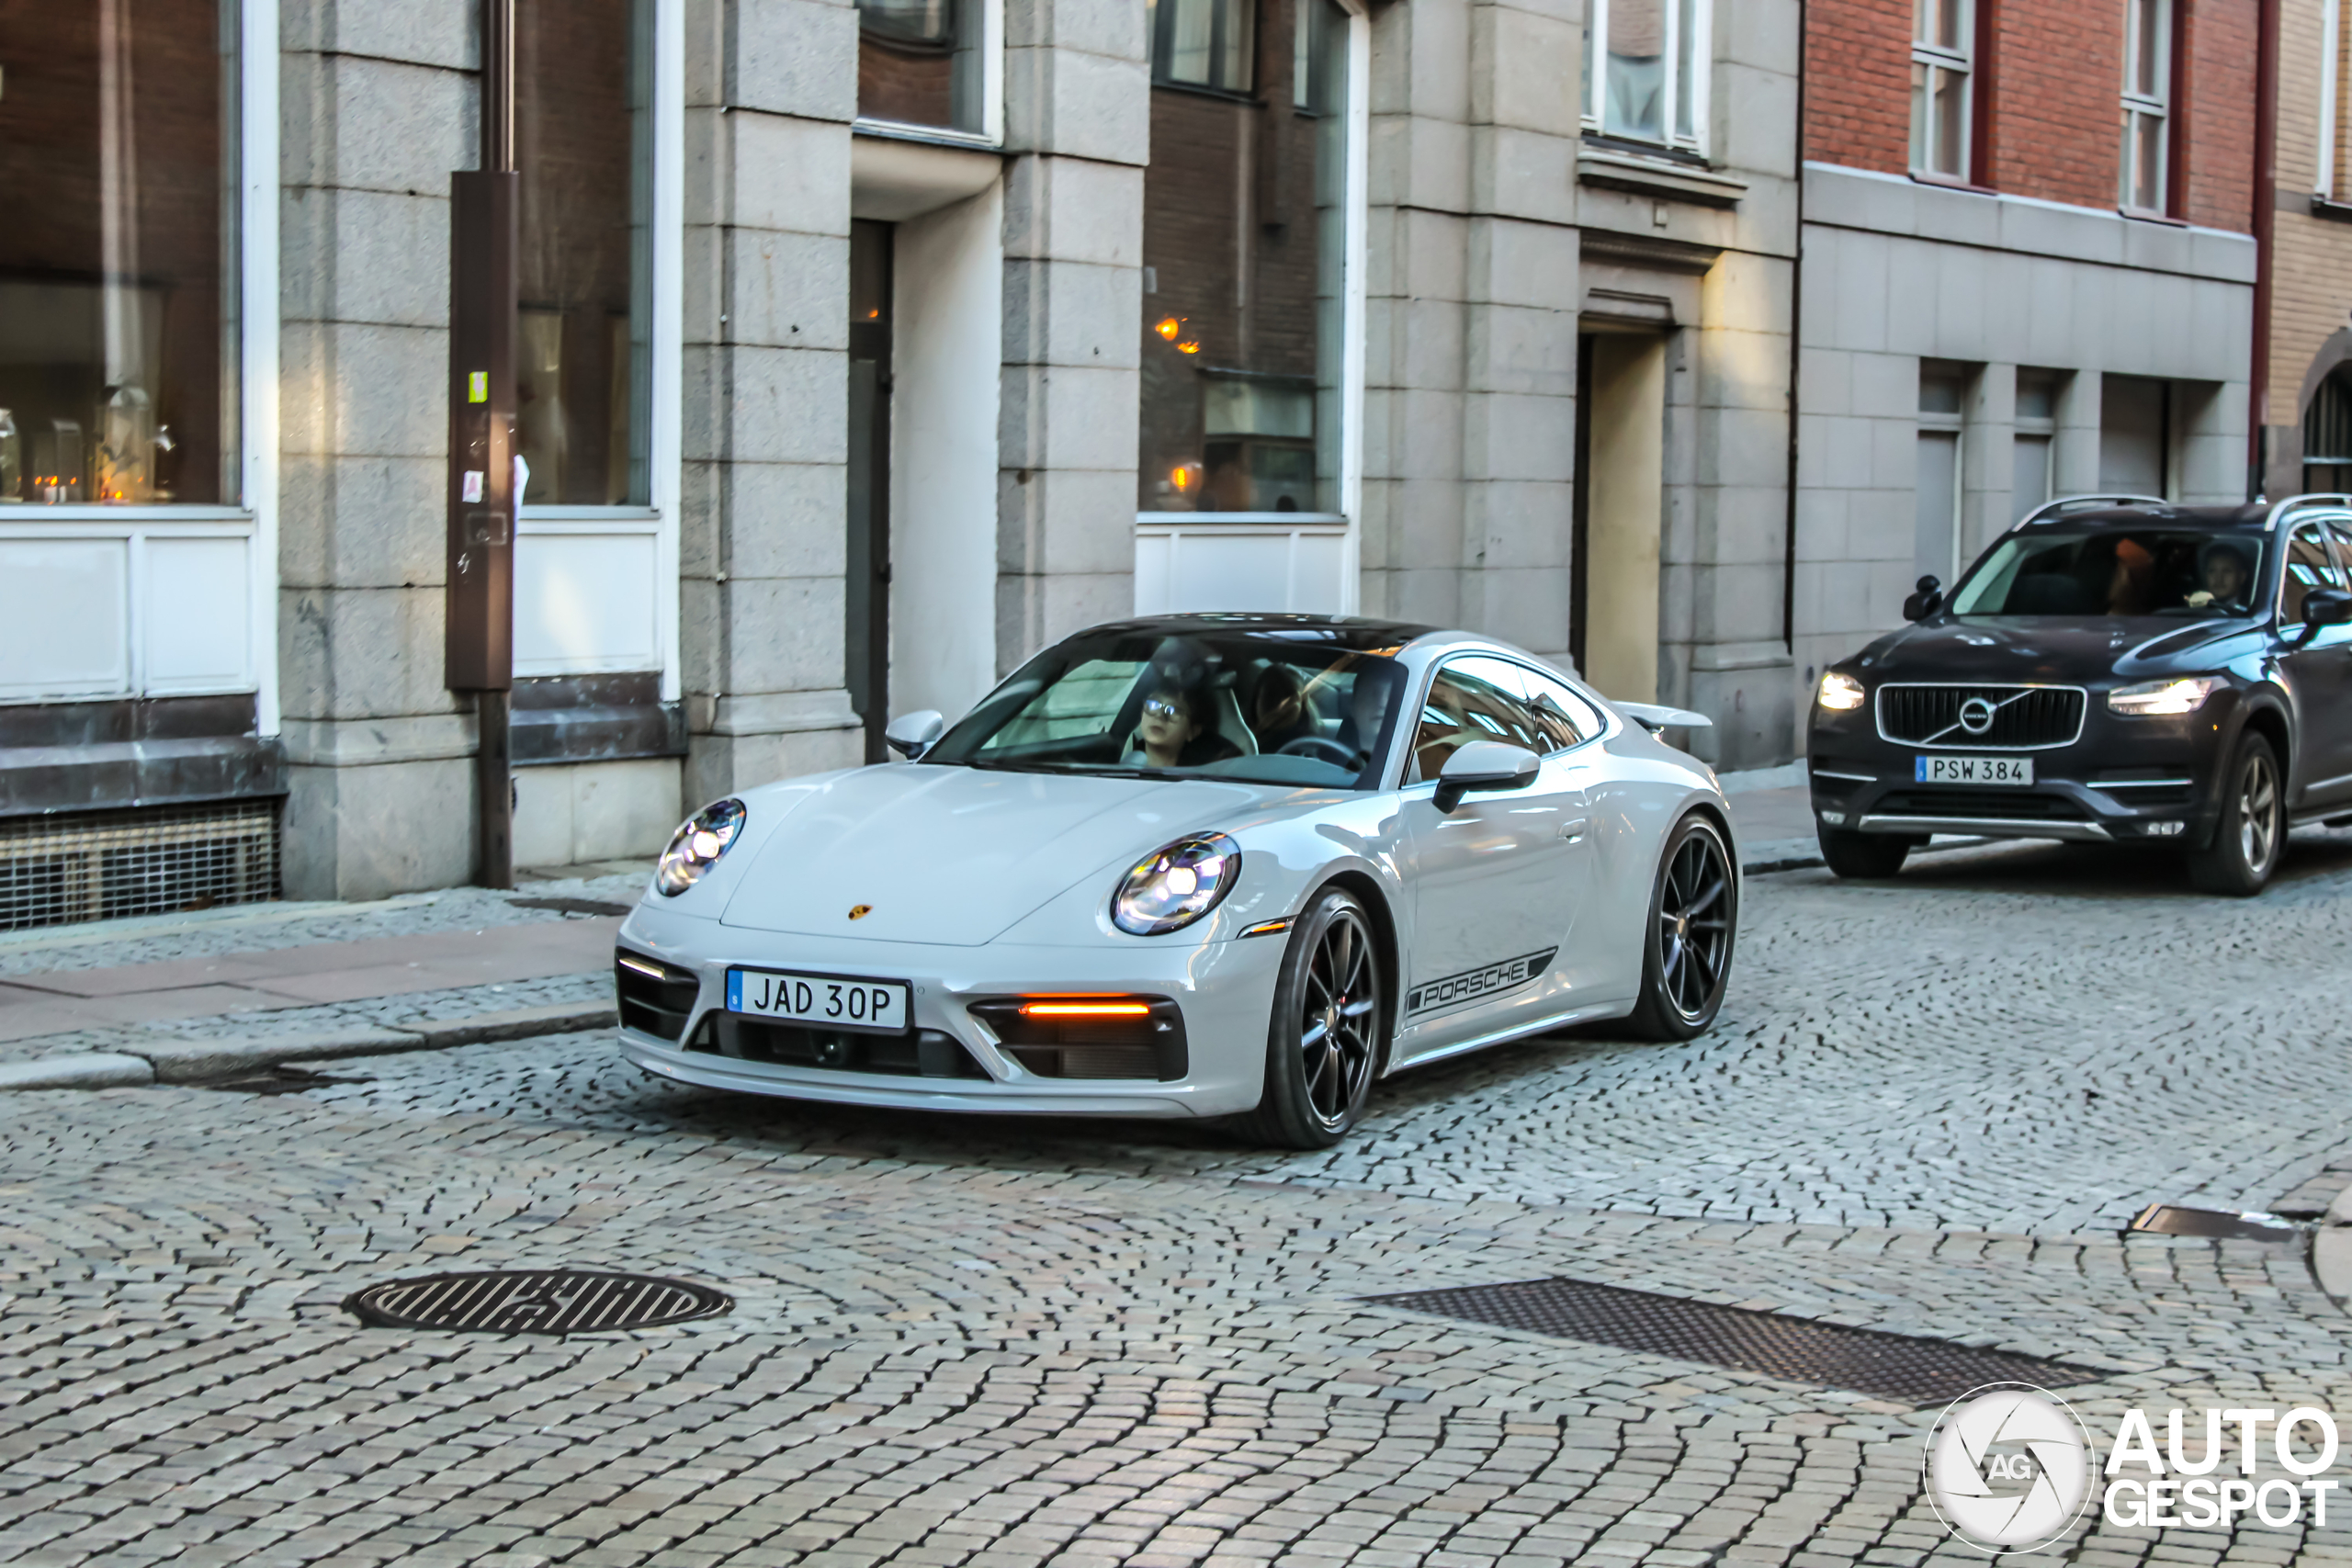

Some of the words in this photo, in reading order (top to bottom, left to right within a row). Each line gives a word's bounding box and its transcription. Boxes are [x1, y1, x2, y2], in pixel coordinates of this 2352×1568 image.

[1934, 760, 1974, 779] PSW
[1982, 761, 2023, 781] 384
[732, 995, 739, 1005] S
[753, 978, 813, 1014] JAD
[825, 984, 890, 1021] 30P
[1423, 961, 1525, 1007] PORSCHE
